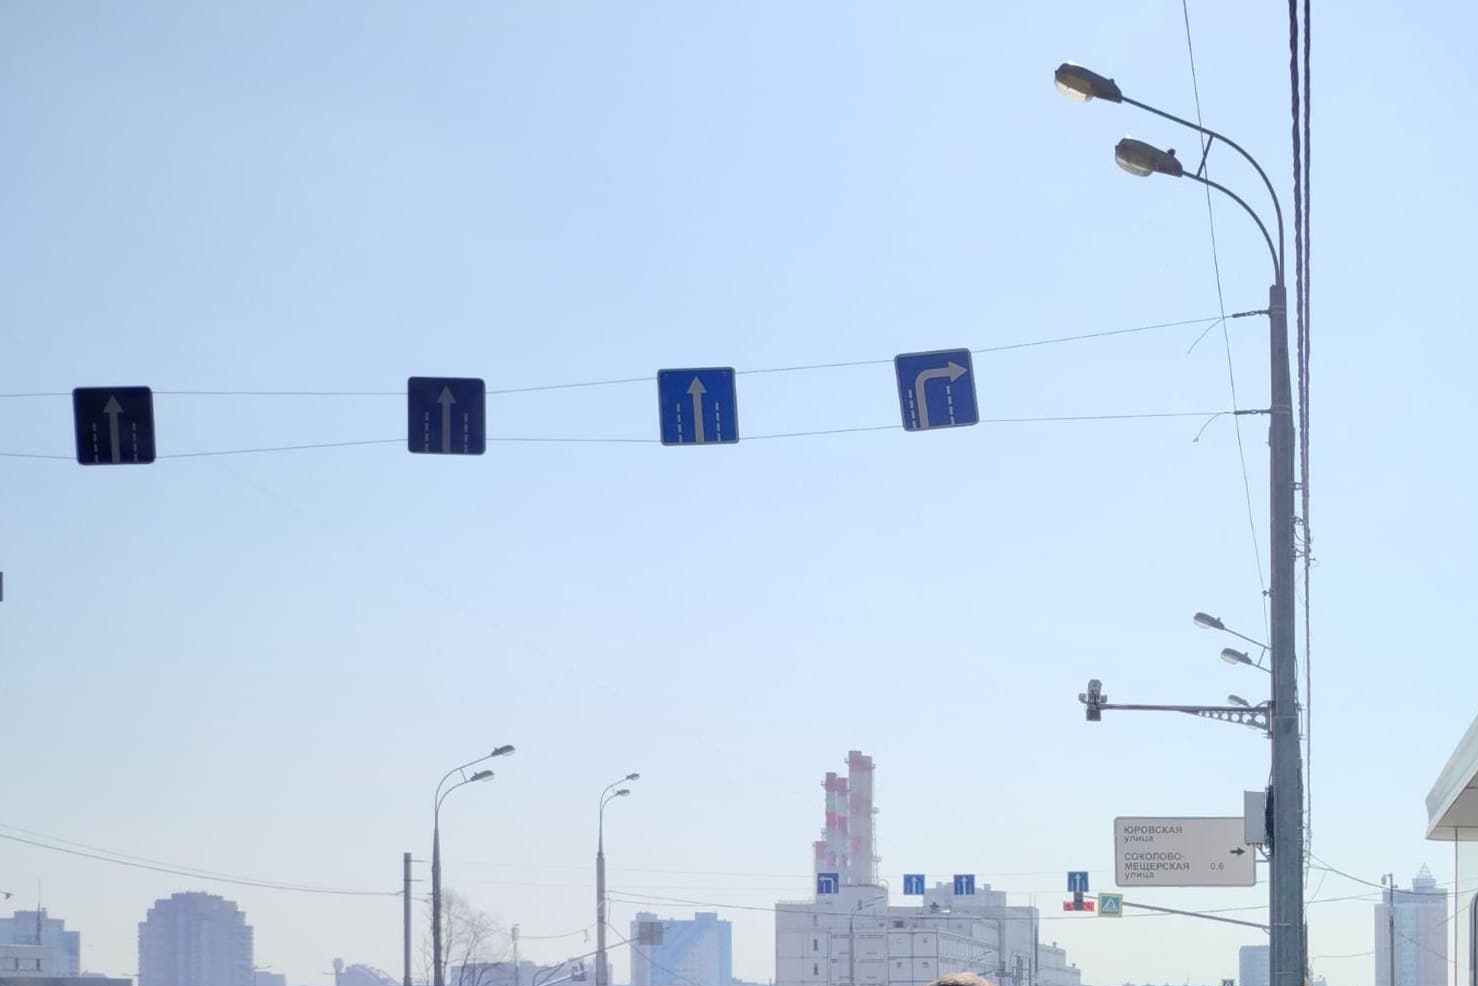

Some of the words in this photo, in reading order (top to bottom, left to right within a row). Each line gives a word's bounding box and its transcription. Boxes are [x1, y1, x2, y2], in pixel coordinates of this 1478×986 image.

[1123, 825, 1184, 835] ЮРОВСКАЯ
[1123, 835, 1154, 844] улица
[1123, 852, 1185, 862] СОКОЛОВО-
[1123, 862, 1191, 872] МЕЩЕРСКАЯ
[1123, 871, 1155, 881] улица
